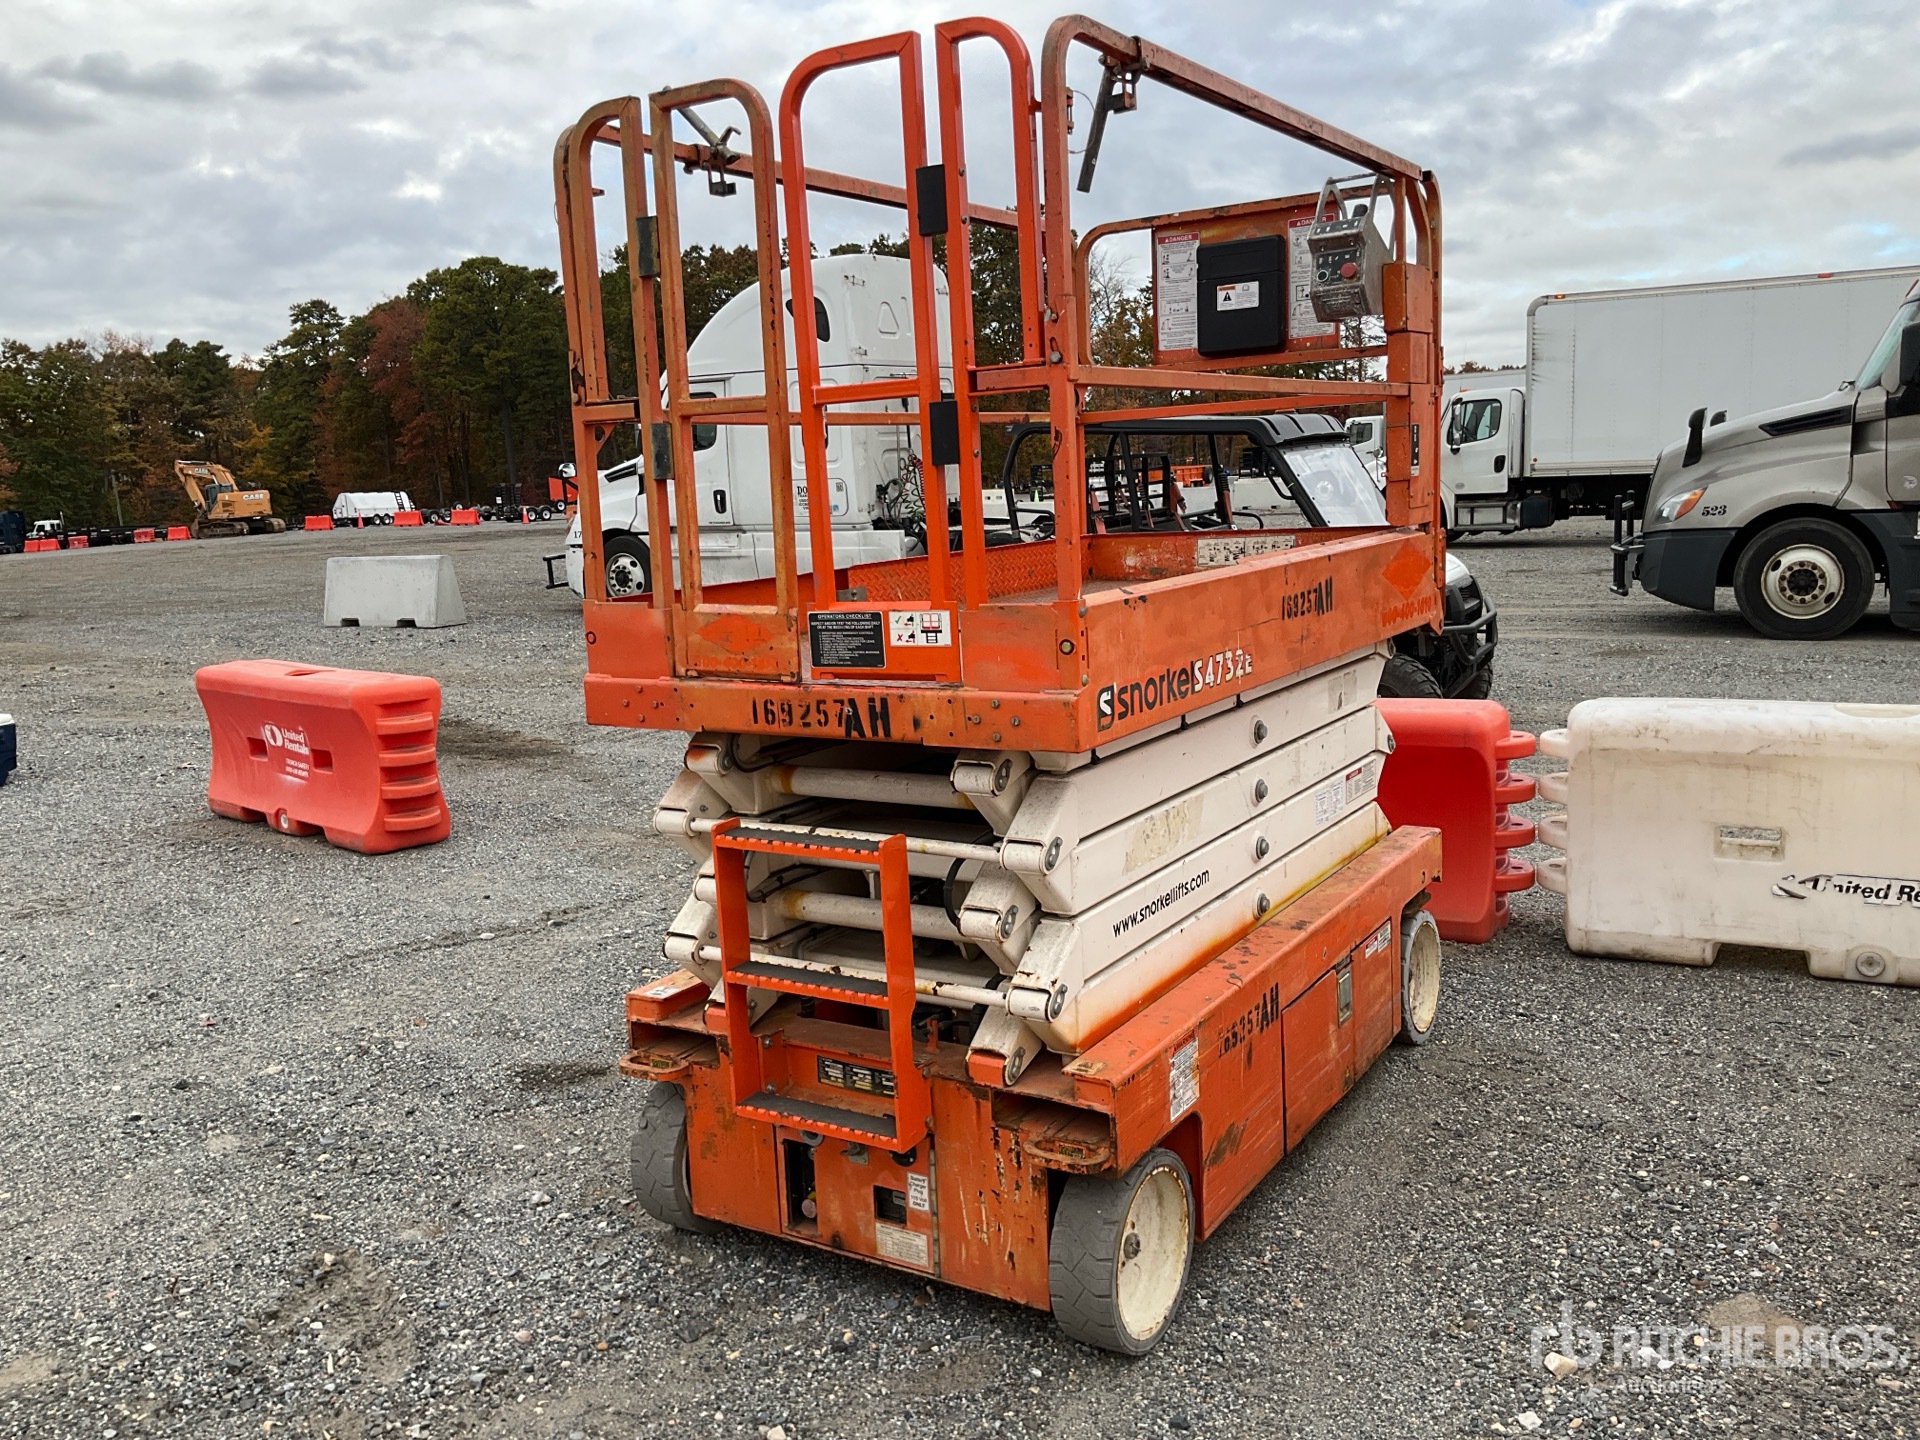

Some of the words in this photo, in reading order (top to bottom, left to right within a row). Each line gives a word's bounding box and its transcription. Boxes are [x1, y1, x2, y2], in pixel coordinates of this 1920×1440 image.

[1168, 234, 1193, 243] DANGER
[1701, 504, 1727, 517] 523
[1281, 575, 1333, 621] 169257AH
[752, 696, 892, 738] 169257AH
[281, 728, 305, 743] United
[284, 739, 310, 755] Rentals
[1811, 877, 1891, 901] United
[1112, 869, 1210, 938] www.snorkellifts.com
